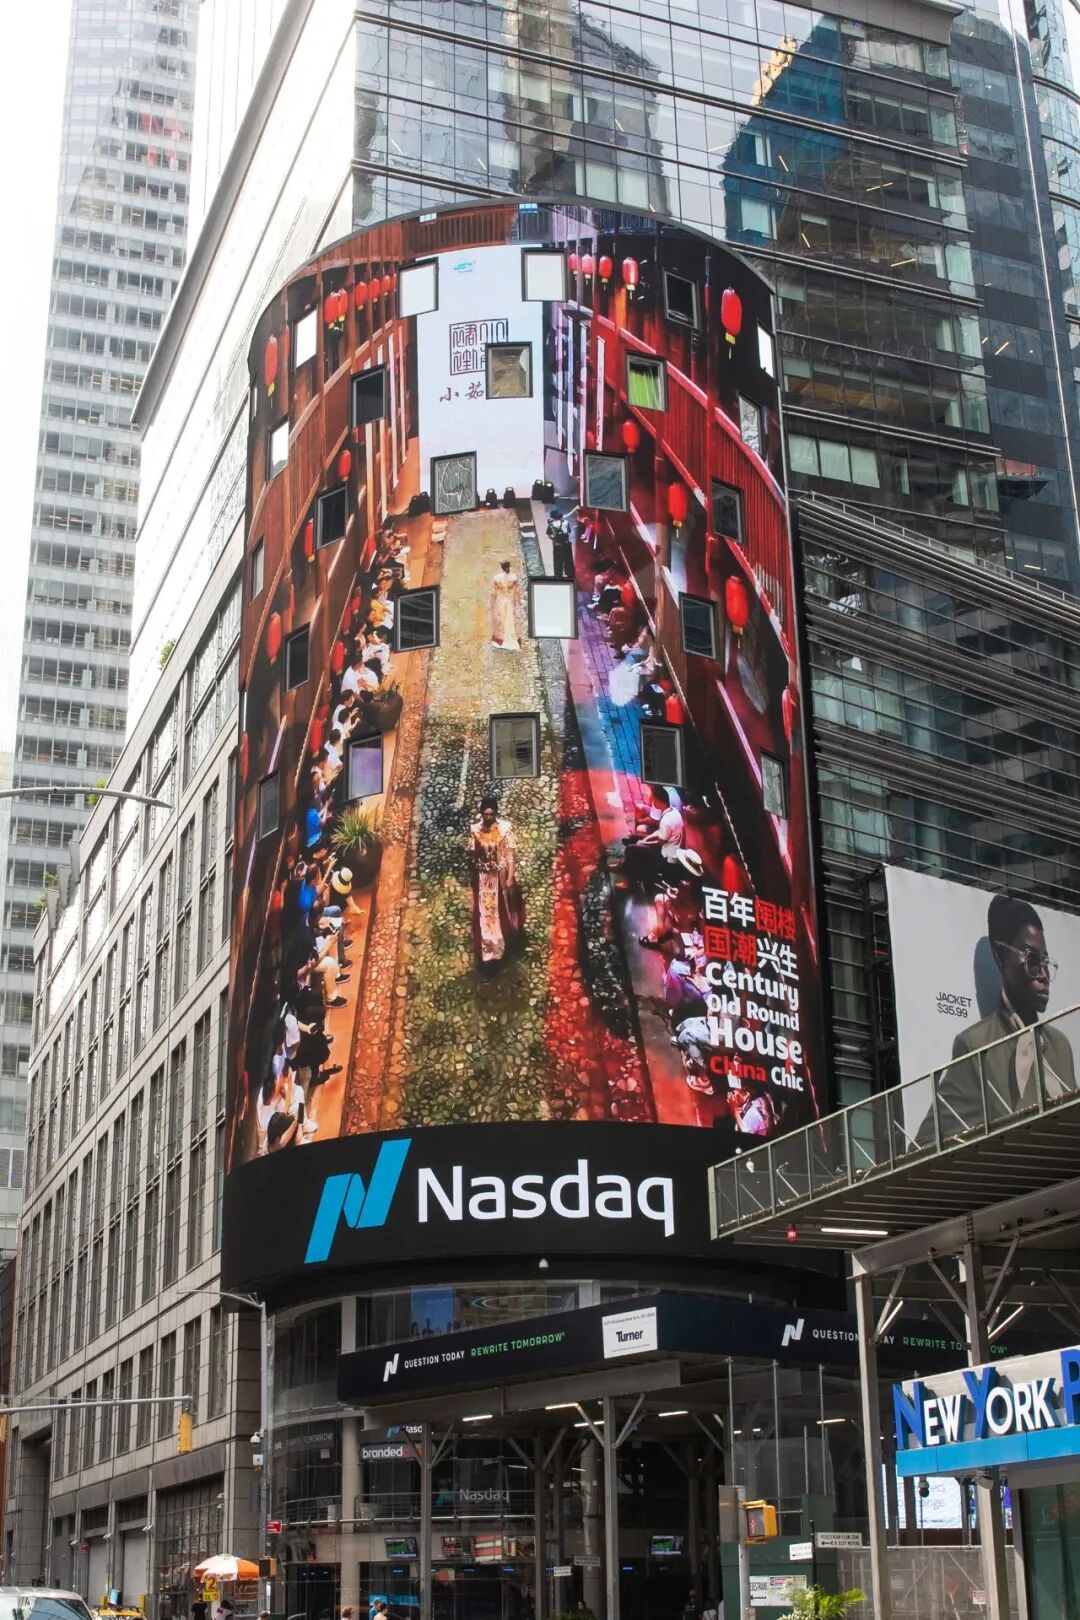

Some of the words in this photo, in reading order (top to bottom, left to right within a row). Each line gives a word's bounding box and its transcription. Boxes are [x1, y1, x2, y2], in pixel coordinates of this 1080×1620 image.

[706, 962, 799, 1011] Century
[936, 992, 972, 1008] JACKET
[707, 993, 741, 1016] Old
[746, 1001, 800, 1031] Round
[937, 1002, 968, 1018] $35.99
[707, 1016, 803, 1065] House
[709, 1055, 767, 1081] China
[771, 1066, 804, 1091] Chic
[418, 1159, 675, 1237] Nasdaq
[404, 1354, 439, 1369] QUESTION
[442, 1350, 465, 1361] TODAY
[471, 1342, 508, 1357] REWRITE
[511, 1333, 563, 1350] TOMORROW
[615, 1330, 644, 1343] Turner
[902, 1336, 947, 1350] REWRITE
[892, 1381, 962, 1450] NEW
[962, 1366, 1056, 1435] YORK
